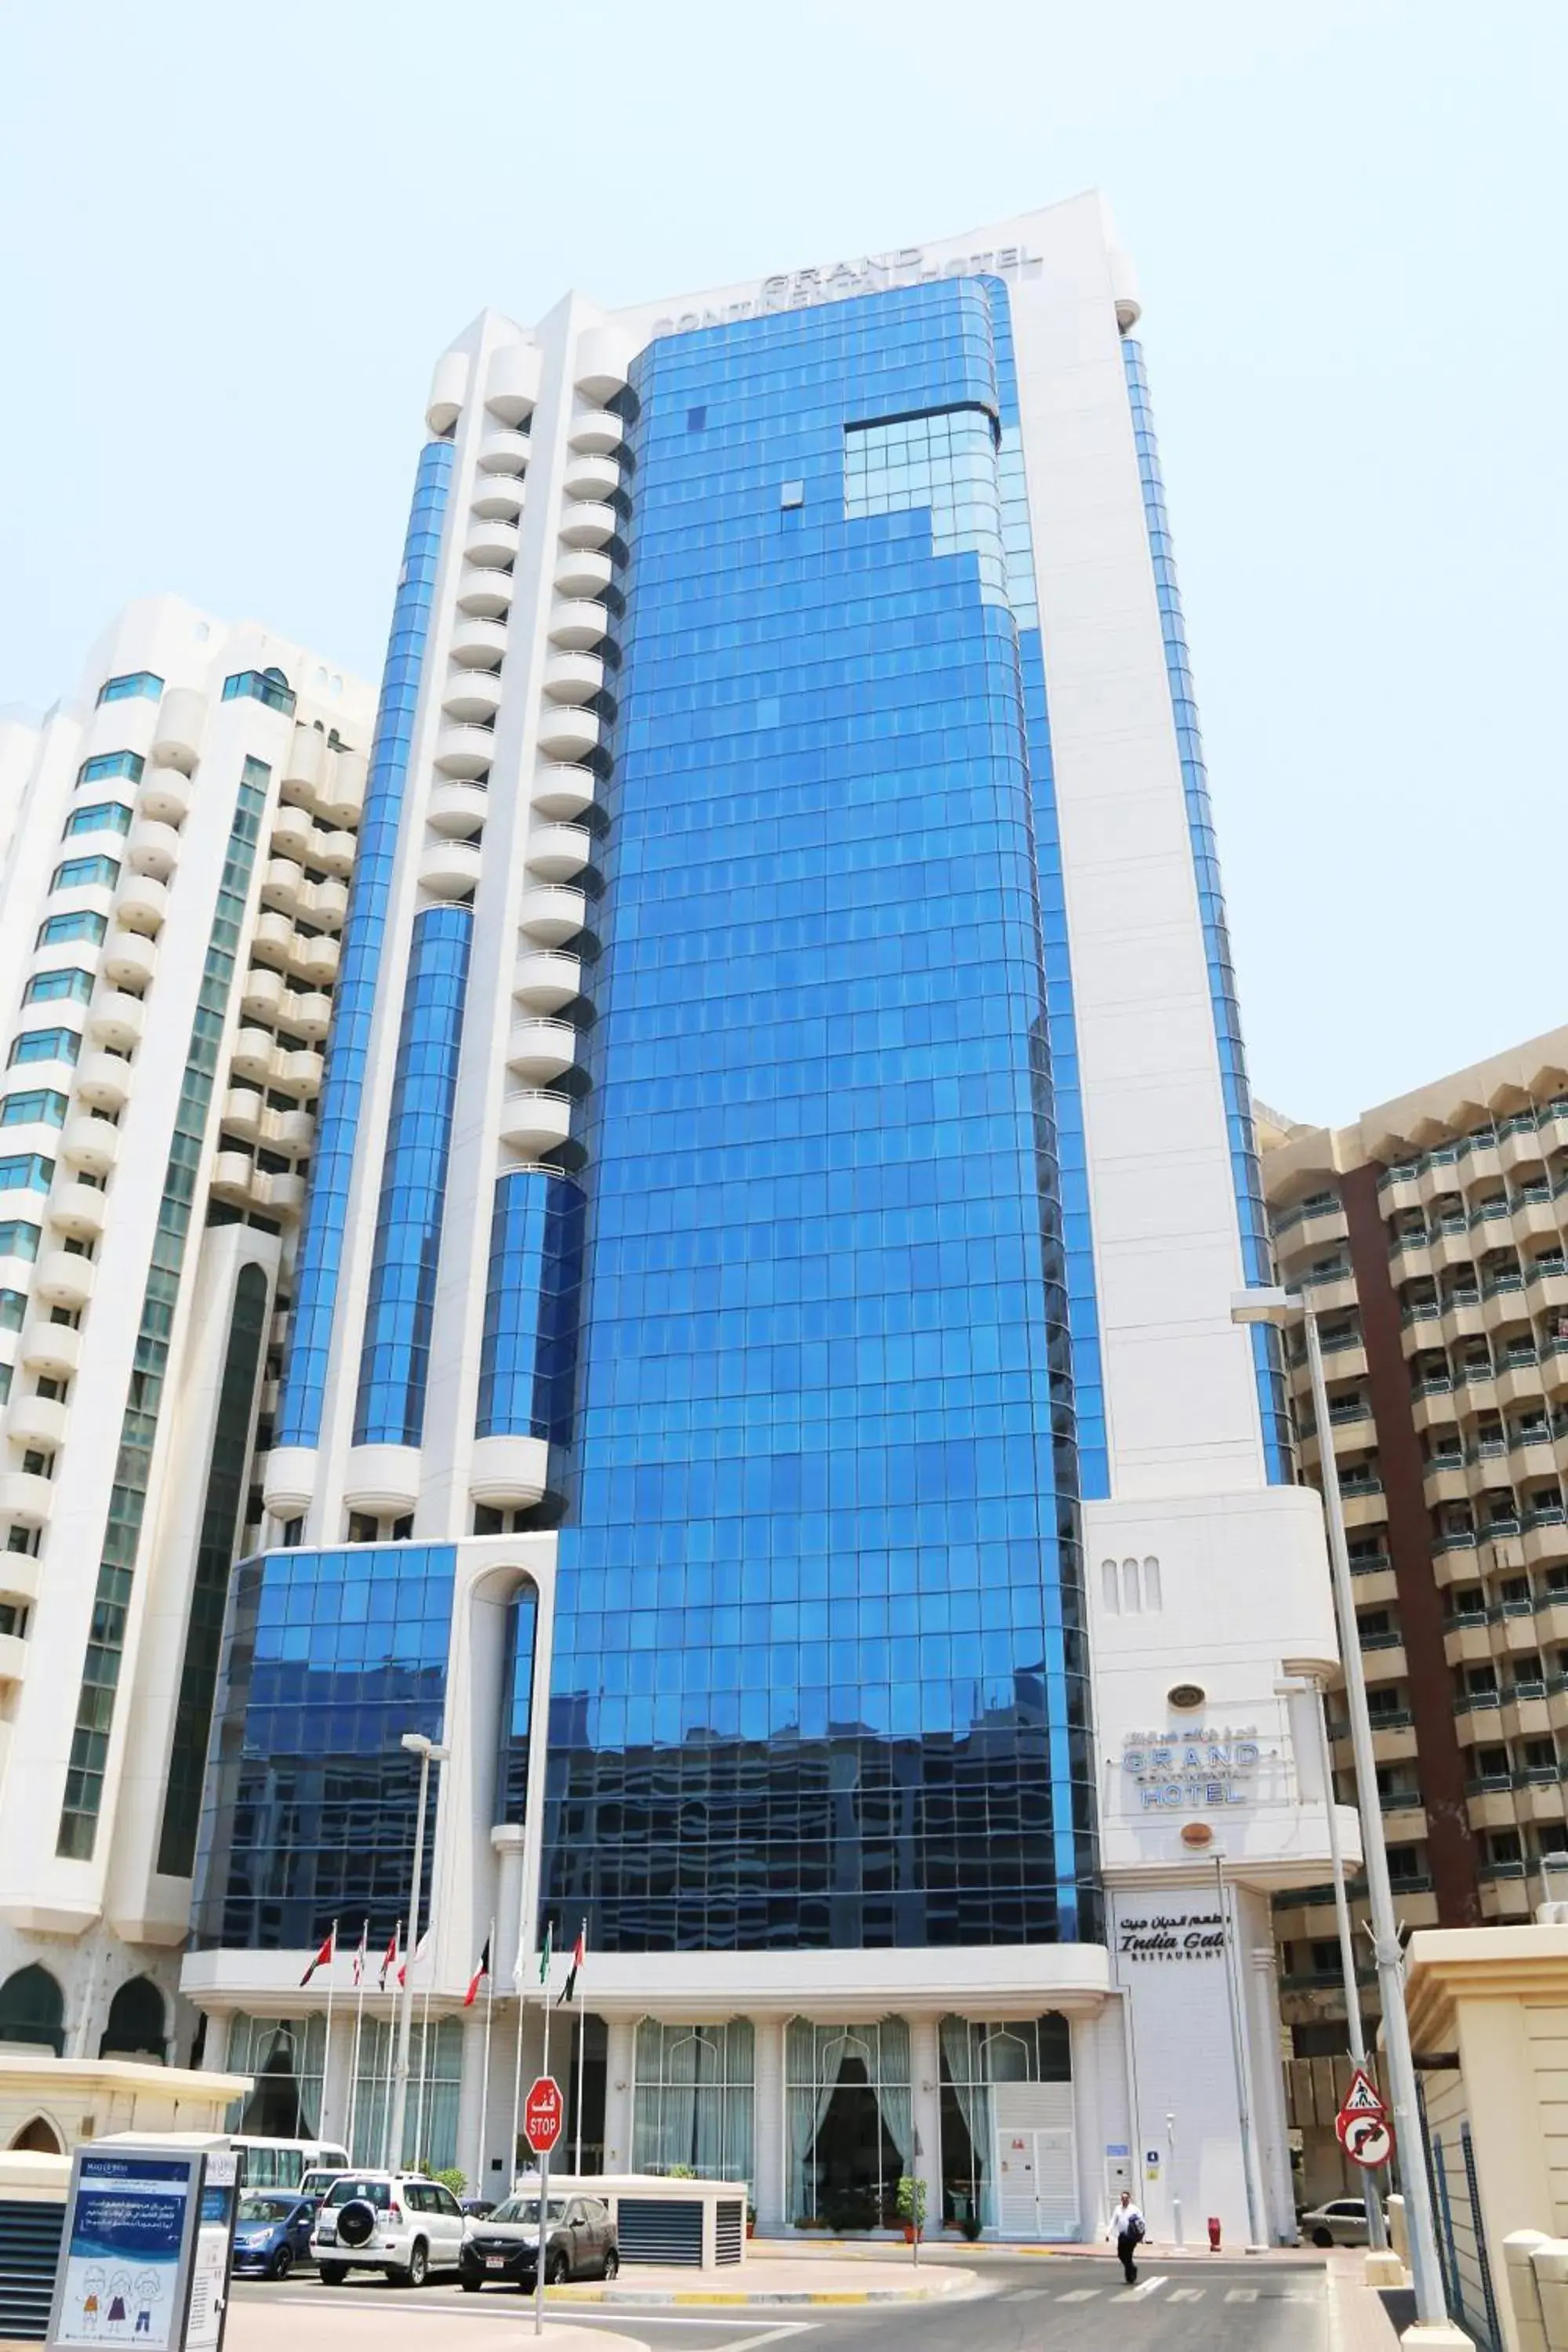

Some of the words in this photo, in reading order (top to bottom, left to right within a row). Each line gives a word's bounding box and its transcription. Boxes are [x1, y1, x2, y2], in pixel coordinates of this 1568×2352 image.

[762, 249, 924, 292] GRAND
[1123, 1742, 1259, 1773] GRAND
[1141, 1783, 1247, 1809] HOTEL
[1119, 1932, 1178, 1951] India
[1131, 1950, 1222, 1962] RESTAURANT
[532, 2088, 555, 2111] قف
[530, 2118, 556, 2136] STOP
